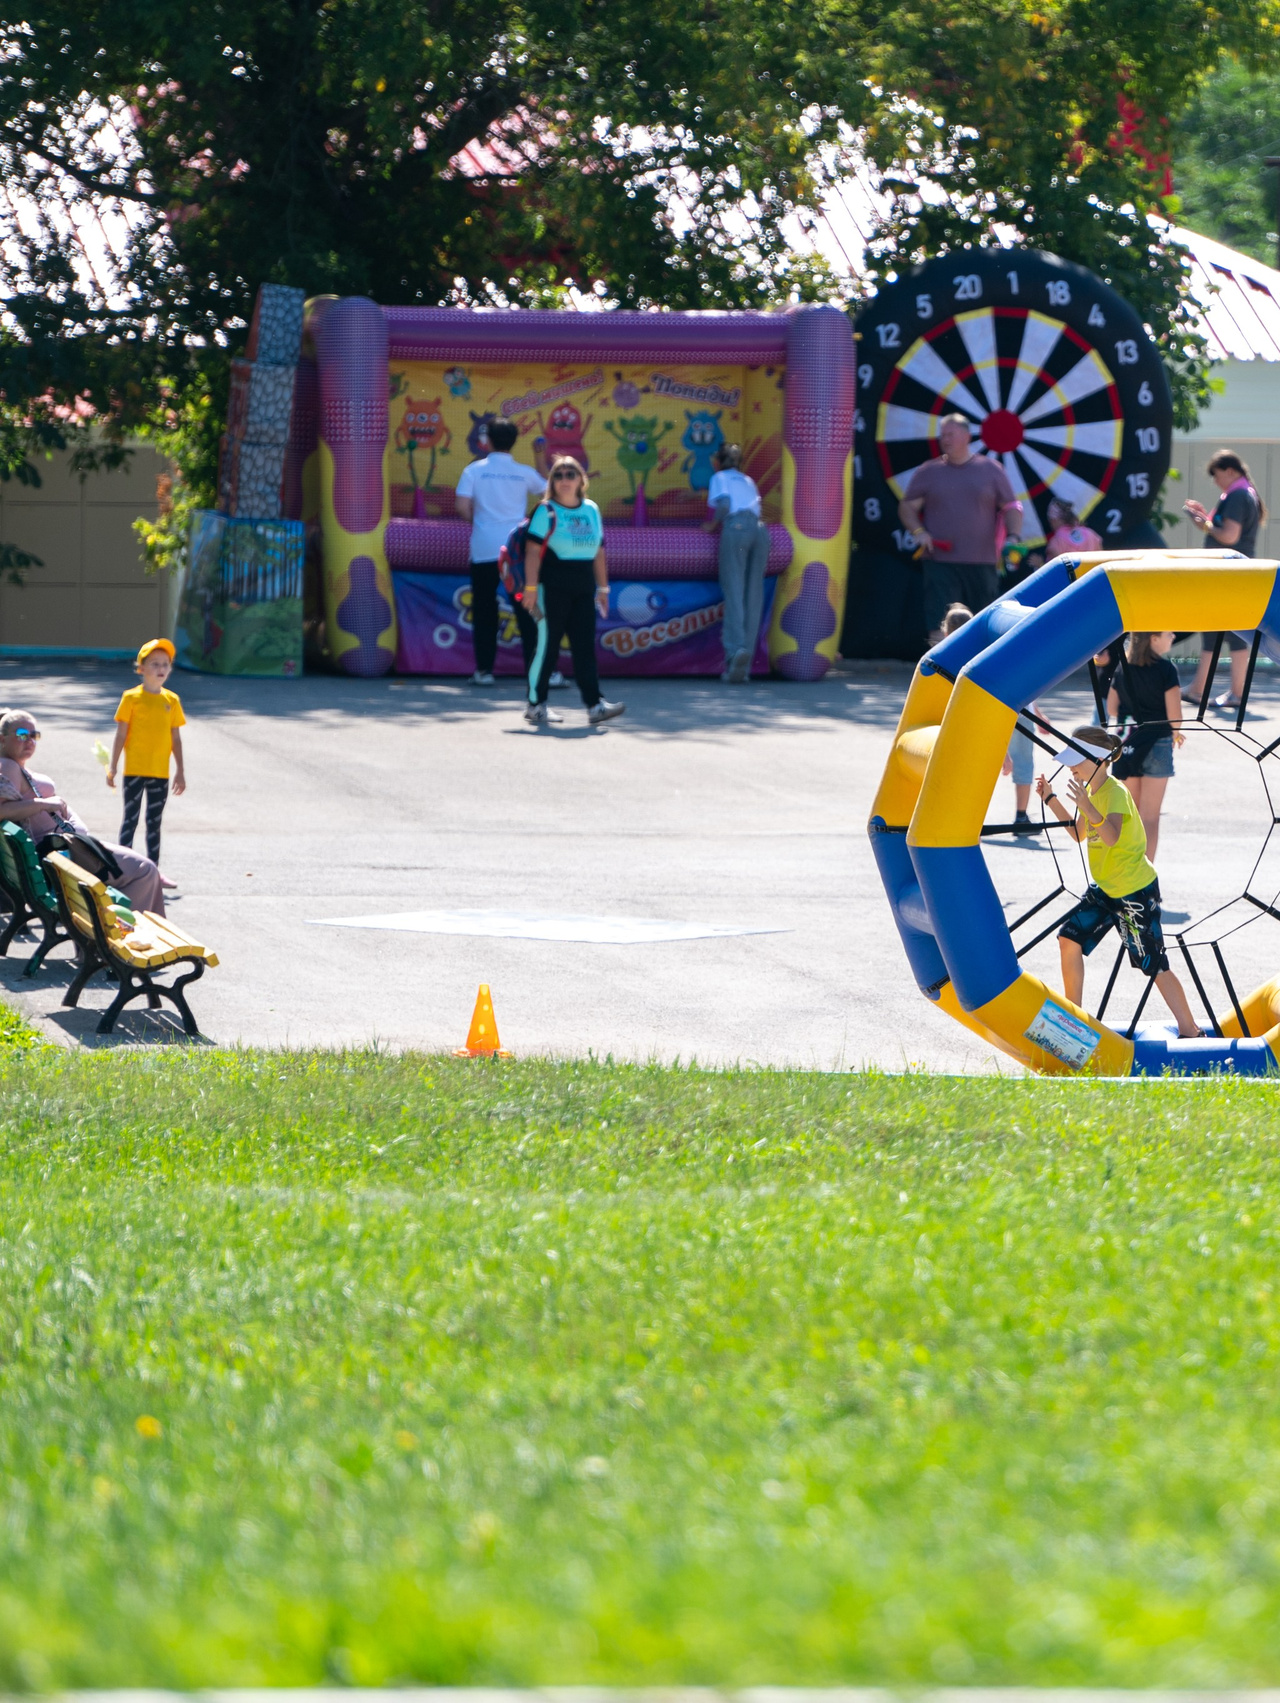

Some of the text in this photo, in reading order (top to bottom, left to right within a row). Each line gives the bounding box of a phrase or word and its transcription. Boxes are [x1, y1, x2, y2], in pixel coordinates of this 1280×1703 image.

[953, 274, 983, 300] 20
[1006, 271, 1019, 295] 1
[1046, 280, 1072, 305] 18
[916, 294, 933, 318] 5
[1087, 304, 1106, 328] 4
[876, 323, 900, 348] 12
[1115, 339, 1139, 364] 13
[858, 364, 874, 389] 9
[651, 373, 741, 406] Попади!
[1138, 381, 1153, 405] 6
[852, 409, 866, 433] 4
[1135, 428, 1160, 453] 10
[1126, 473, 1149, 498] 15
[864, 497, 882, 522] 8
[1106, 509, 1122, 533] 2
